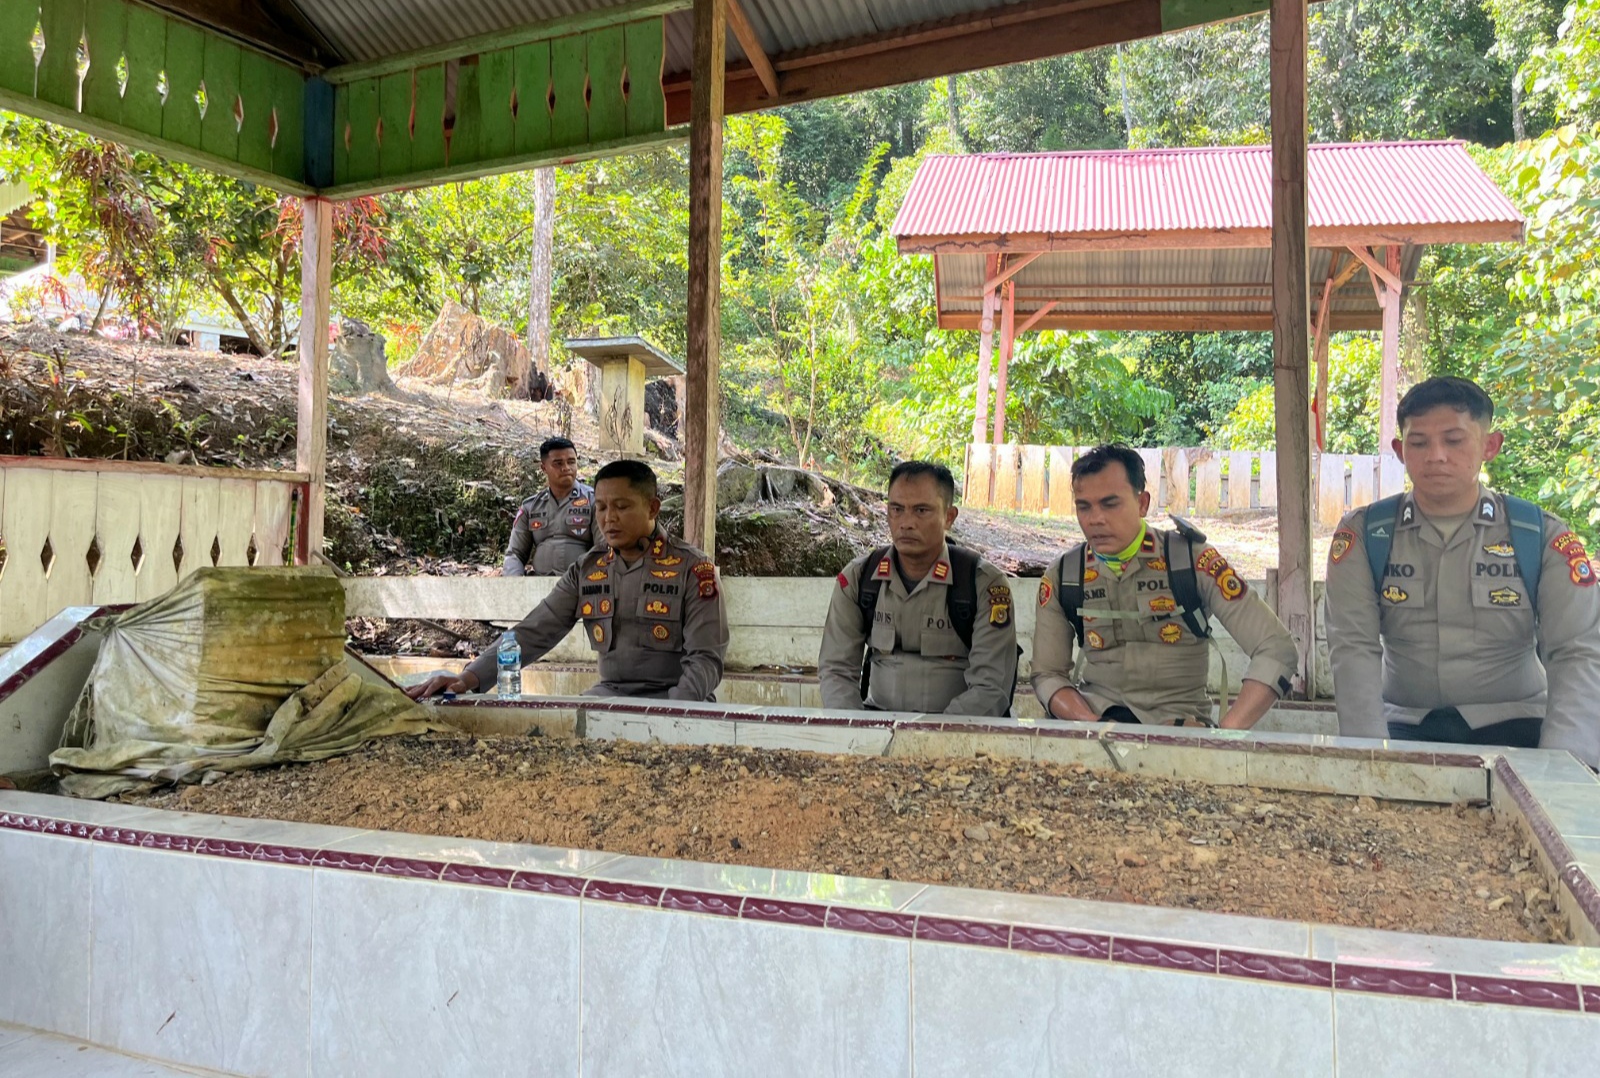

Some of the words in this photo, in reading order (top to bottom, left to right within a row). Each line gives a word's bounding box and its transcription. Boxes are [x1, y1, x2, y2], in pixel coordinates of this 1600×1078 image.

[568, 507, 591, 515] POLRI
[1209, 558, 1227, 576] ACEH
[1386, 563, 1416, 577] KO
[643, 582, 679, 595] POLRI
[1136, 579, 1170, 592] POL
[926, 617, 953, 630] POL
